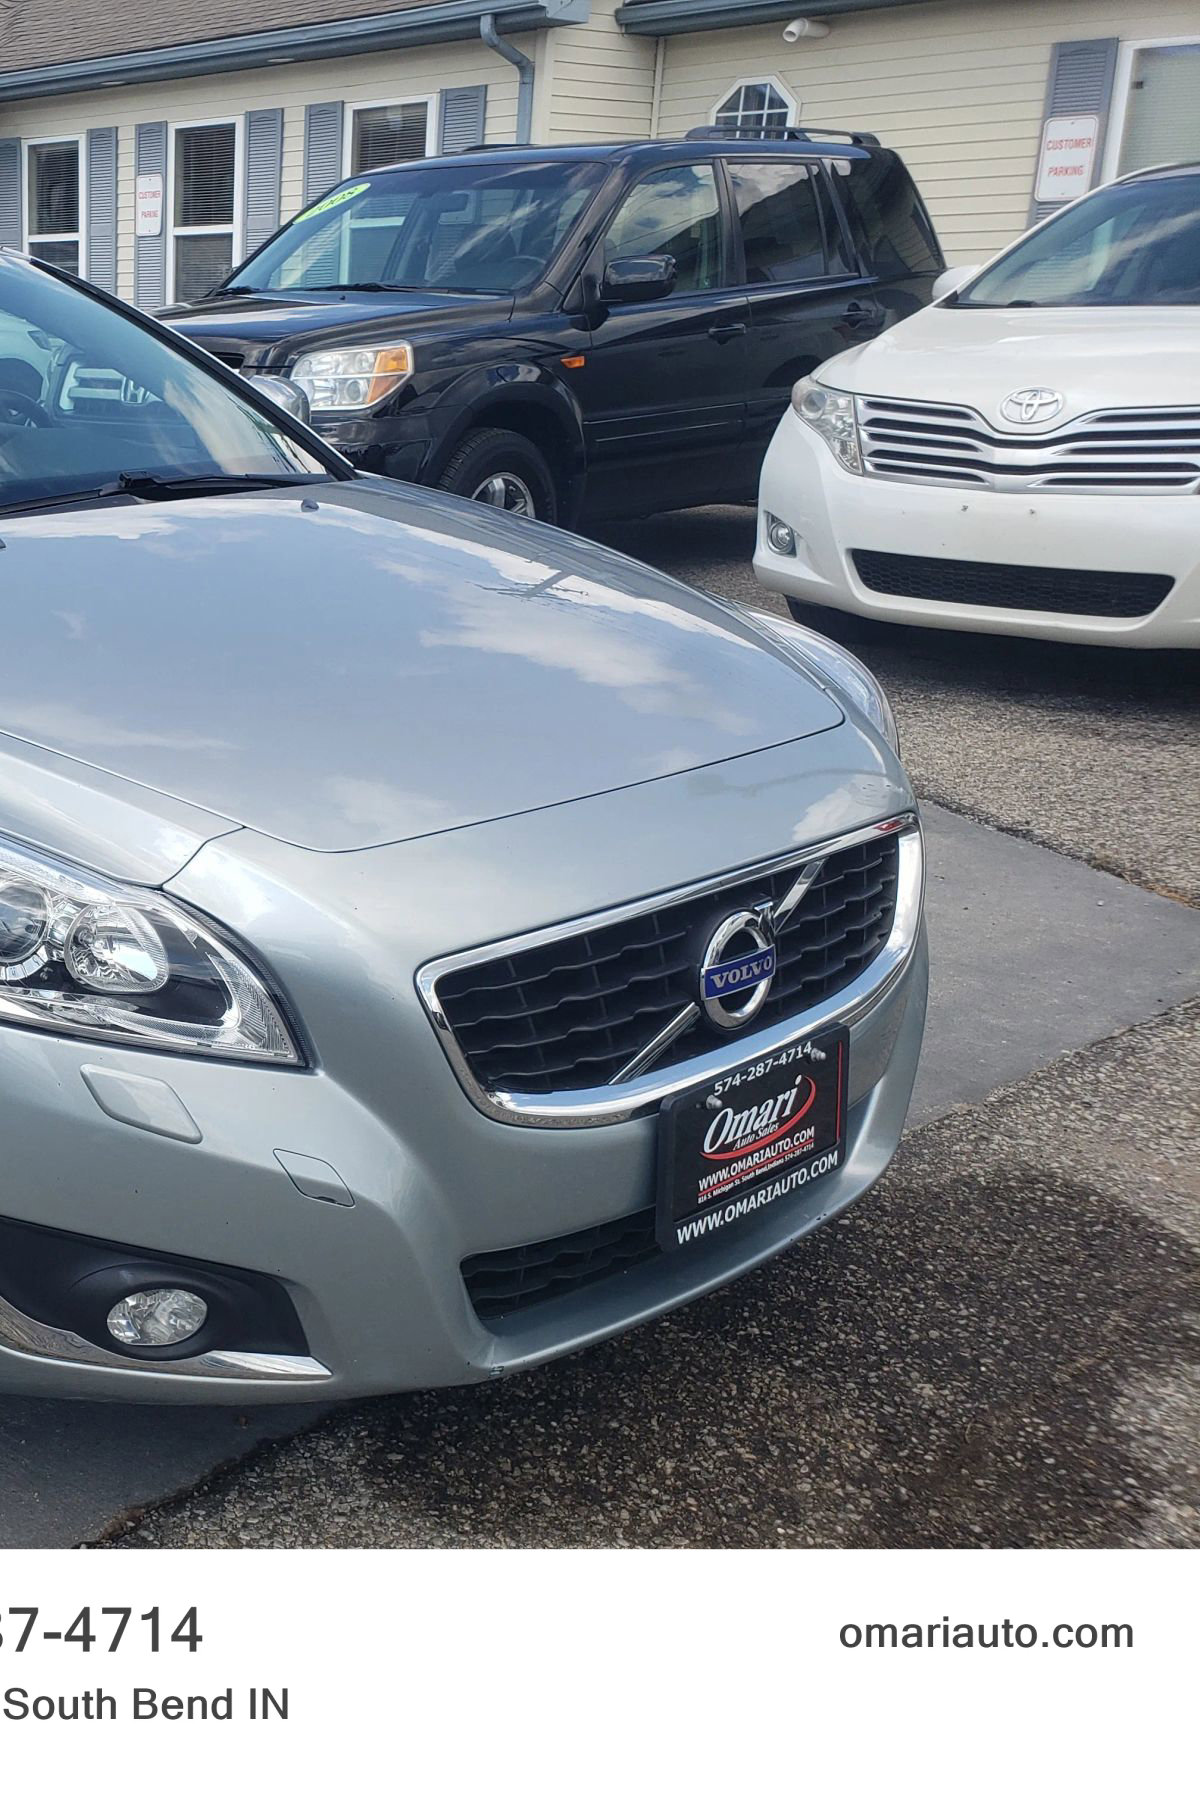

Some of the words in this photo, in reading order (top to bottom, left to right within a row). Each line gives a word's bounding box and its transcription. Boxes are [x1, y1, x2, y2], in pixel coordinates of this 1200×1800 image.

[1046, 137, 1092, 151] CUSTOMER
[1047, 164, 1085, 177] PARKING
[710, 956, 773, 989] VOLVO
[713, 1040, 813, 1096] 574-287-4714
[703, 1074, 803, 1154] Omari
[732, 1134, 756, 1151] Auto
[755, 1121, 780, 1140] Sales
[698, 1125, 816, 1192] WWW.OMARIAUTO.COM
[676, 1150, 839, 1245] WWW.OMARIAUTO.COM
